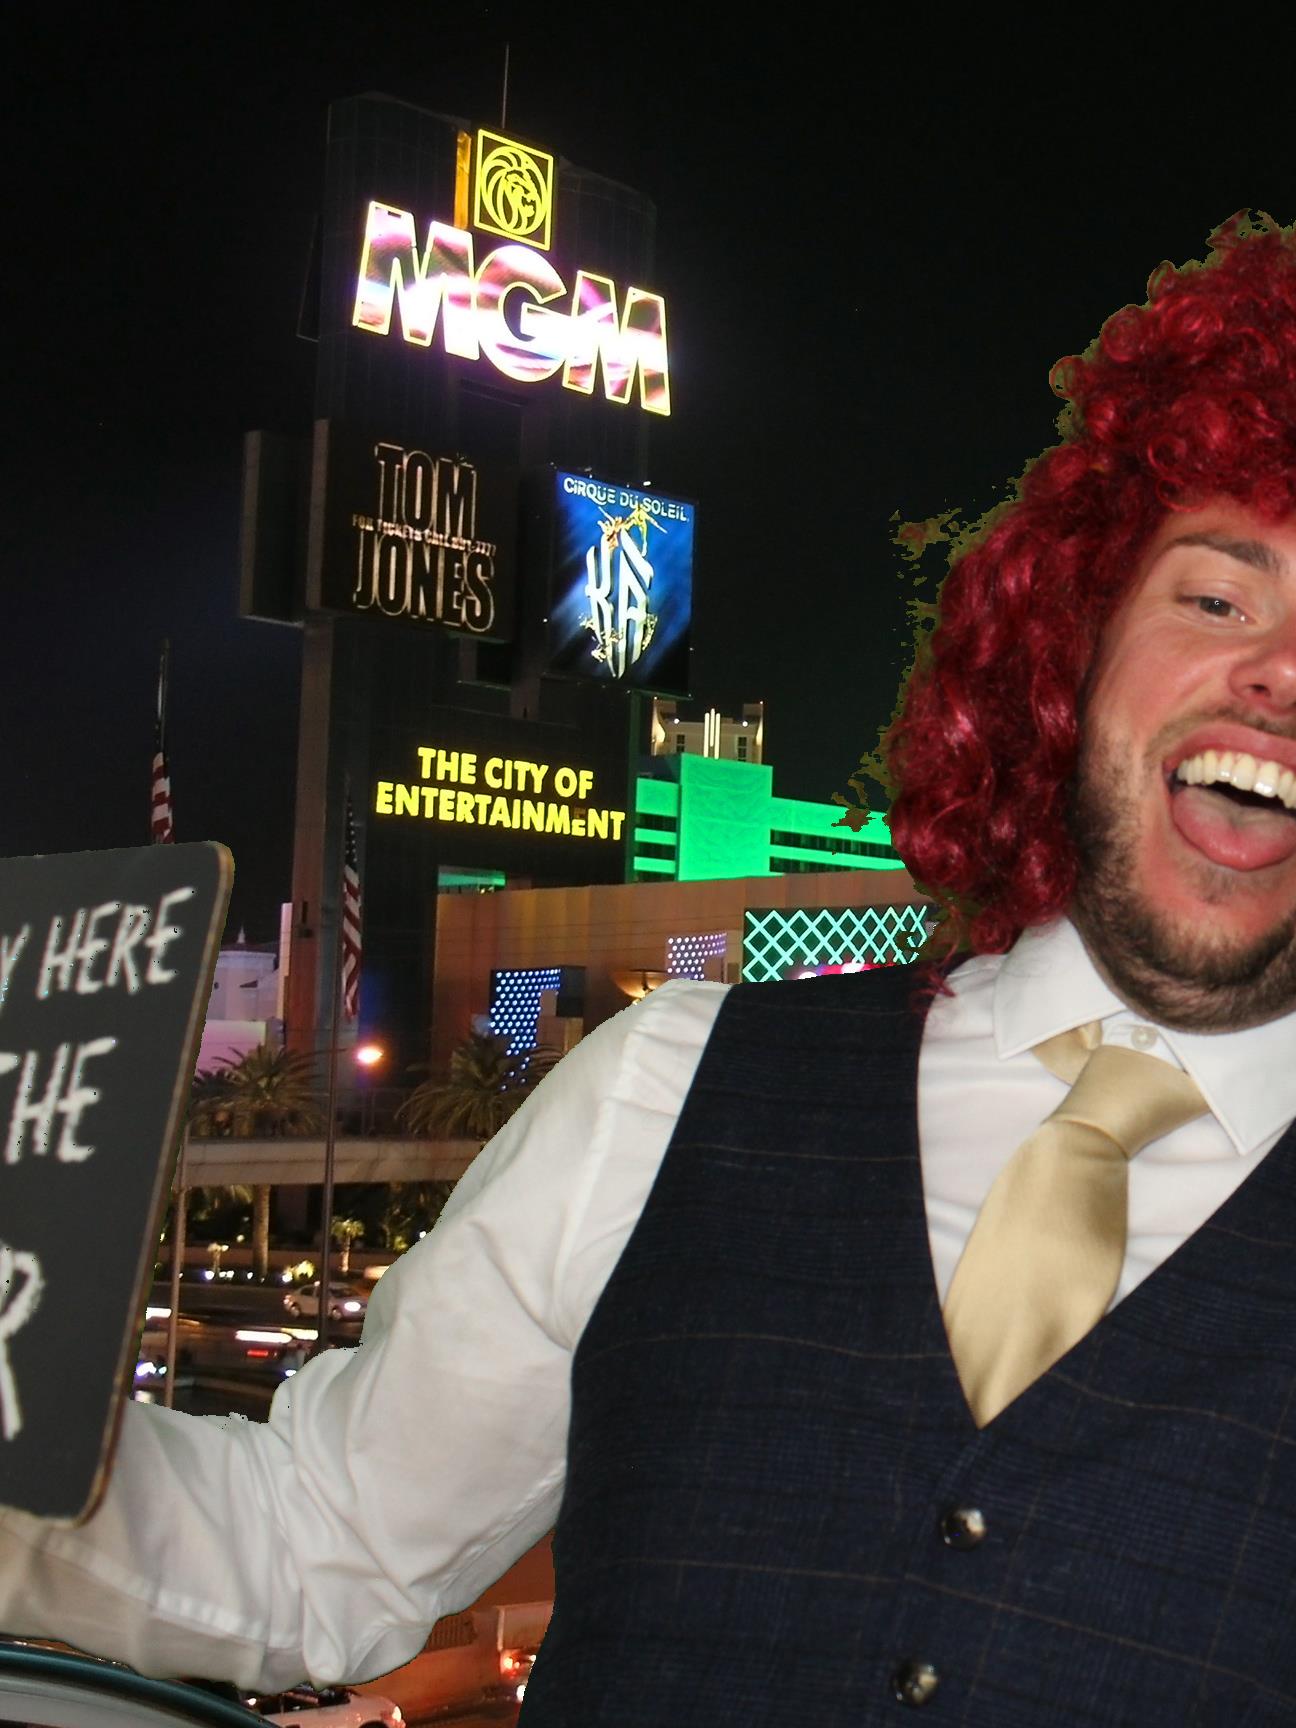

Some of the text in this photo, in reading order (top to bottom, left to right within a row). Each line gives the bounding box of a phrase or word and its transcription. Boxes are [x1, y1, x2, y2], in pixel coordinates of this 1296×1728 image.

[353, 201, 671, 415] MGM
[374, 442, 477, 539] TOM
[563, 477, 688, 522] CIRQUE DU SOLEIL
[352, 531, 496, 632] JONES
[376, 781, 626, 840] ENTERTAINMENT
[417, 747, 594, 799] THE CITY OF
[36, 886, 194, 1000] HERE
[0, 1036, 118, 1165] HE
